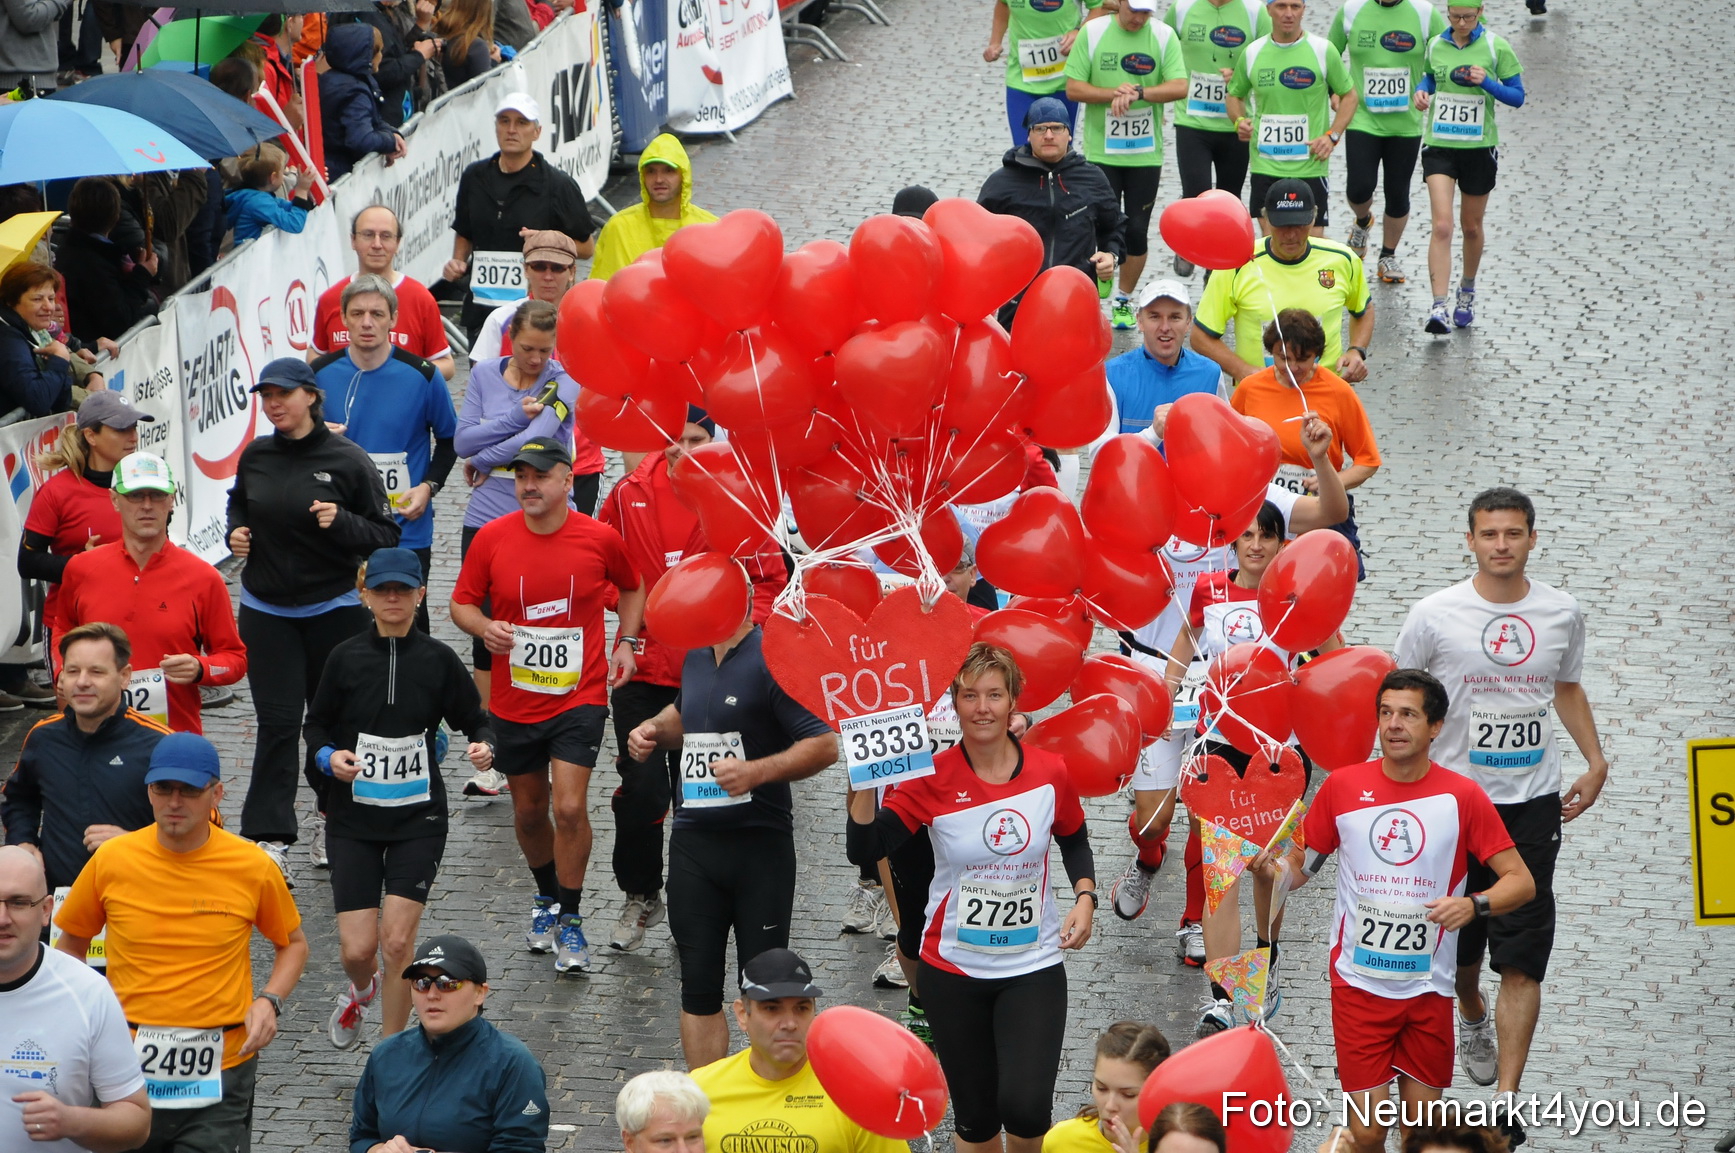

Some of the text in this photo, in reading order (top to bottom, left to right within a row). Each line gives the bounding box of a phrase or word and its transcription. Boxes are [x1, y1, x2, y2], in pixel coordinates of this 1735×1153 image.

[1028, 47, 1058, 65] 110
[1036, 66, 1055, 75] Stefan
[1368, 78, 1406, 95] 2209
[1438, 104, 1478, 123] 2151
[1110, 119, 1150, 136] 2152
[1264, 126, 1304, 142] 2150
[1437, 124, 1478, 134] Ann-Christin
[477, 265, 521, 286] 3073
[537, 605, 556, 614] DEHN
[524, 643, 568, 668] 208
[849, 634, 888, 662] für
[532, 672, 558, 684] Mario
[1464, 675, 1500, 683] LAUFEN
[1526, 674, 1548, 683] HERZ
[820, 659, 931, 721] ROSI
[841, 711, 911, 732] PARTL Neumarkt
[1472, 711, 1536, 720] PARTL Neumarkt
[852, 722, 923, 761] 3333
[1477, 721, 1541, 749] 2730
[359, 741, 416, 752] PARTL Neumarkt
[363, 752, 422, 780] 3144
[686, 751, 737, 778] 256
[1486, 754, 1531, 766] Raimund
[698, 786, 722, 796] Peter
[1230, 790, 1256, 809] für
[1214, 807, 1285, 836] Regina
[1354, 871, 1437, 889] LAUFEN MIT HERZ
[961, 885, 1027, 897] PARTL Neumarkt
[1406, 890, 1429, 898] Röschl
[966, 897, 1033, 927] 2725
[1358, 903, 1423, 920] PARTL Neumarkt
[990, 934, 1008, 944] Eva
[1361, 918, 1427, 951] 2723
[1365, 954, 1416, 970] Johannes
[138, 1030, 208, 1043] PARTL Neumarkt
[141, 1044, 214, 1076] 2499
[147, 1083, 200, 1099] Reinhard
[744, 1121, 793, 1137] PIZZERIA
[732, 1137, 805, 1153] FRANCESCO
